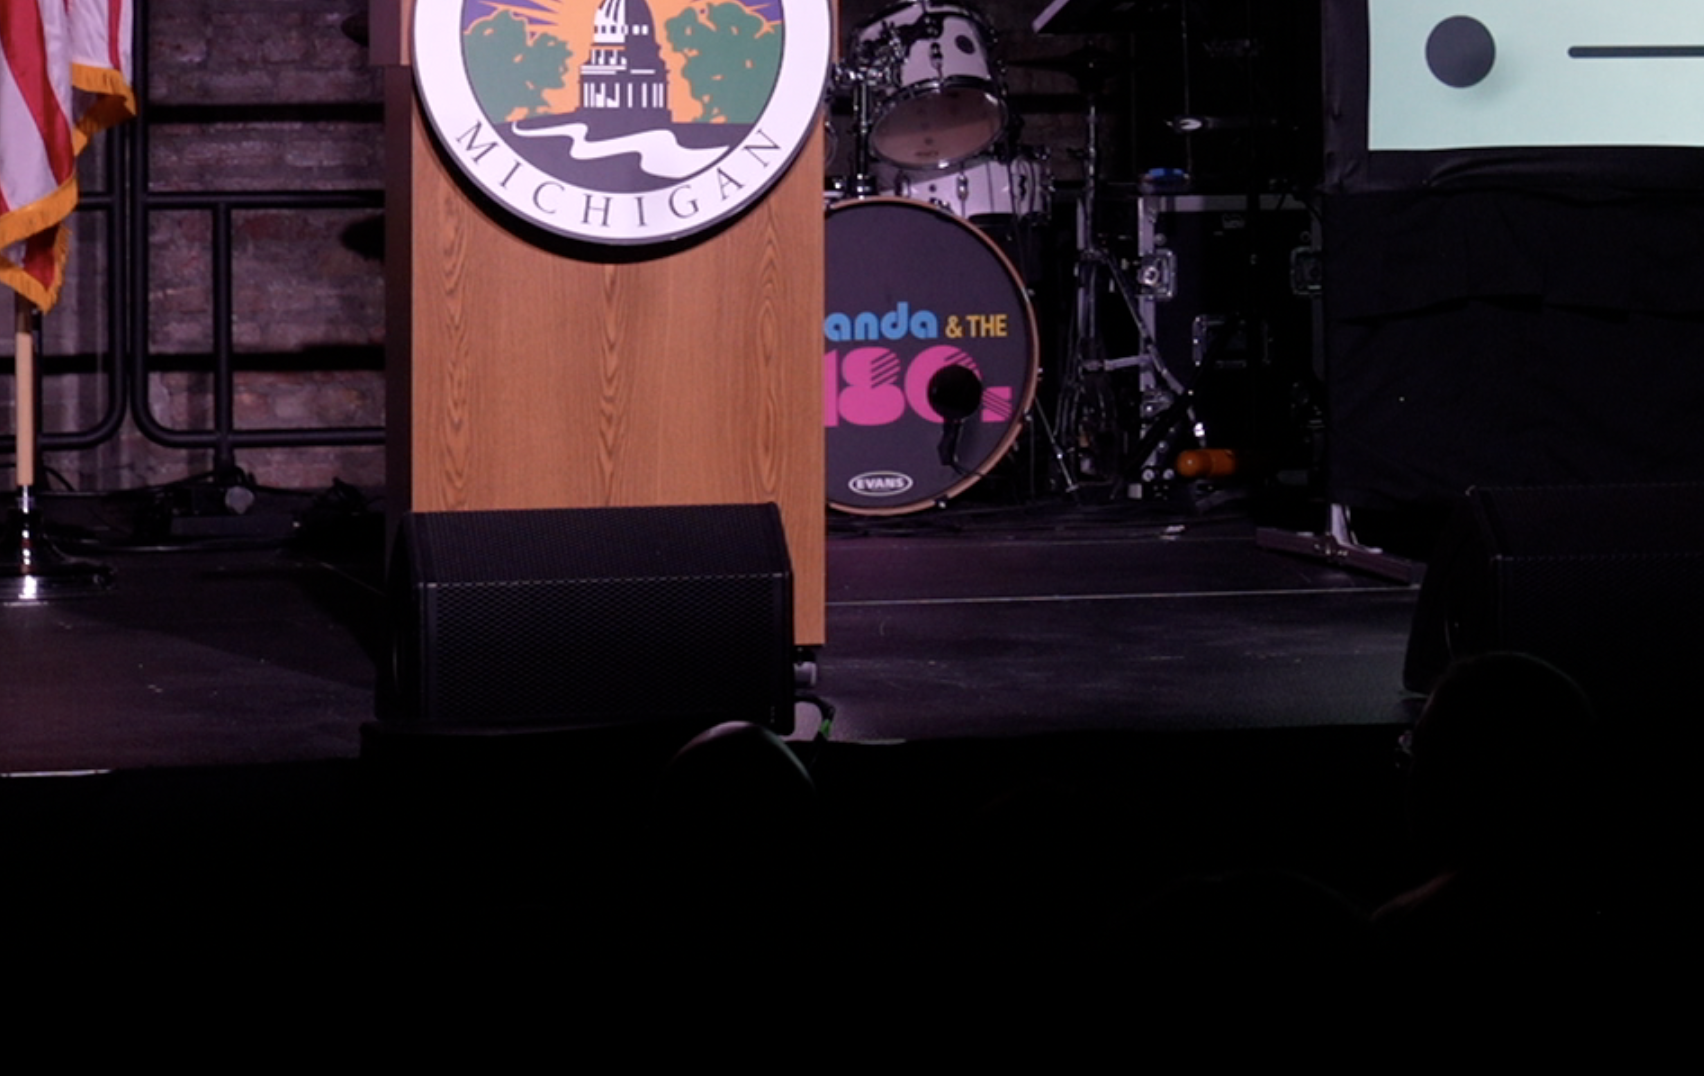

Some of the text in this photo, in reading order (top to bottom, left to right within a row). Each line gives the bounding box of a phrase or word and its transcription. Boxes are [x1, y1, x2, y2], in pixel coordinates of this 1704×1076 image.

[455, 121, 782, 228] MICHIGAN
[945, 315, 963, 339] &
[966, 314, 1009, 338] THE
[856, 477, 905, 490] EVANS
